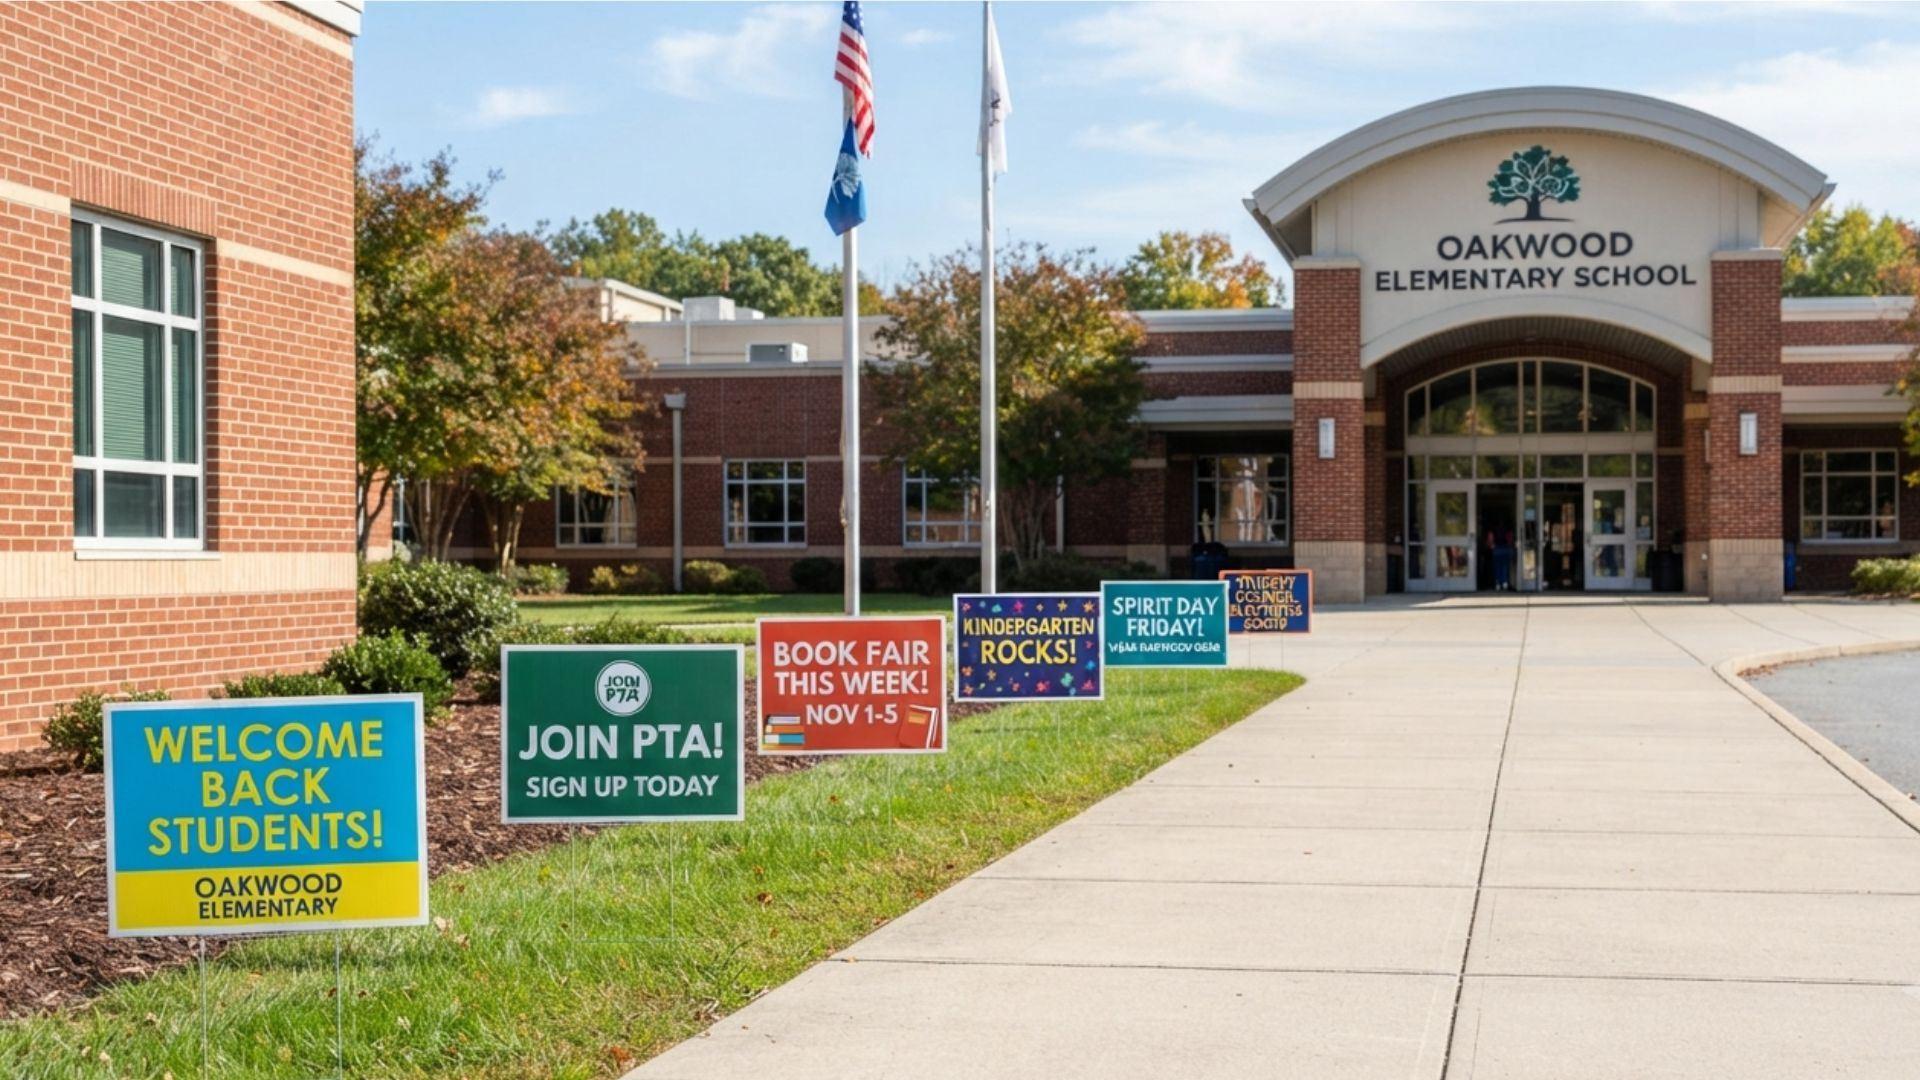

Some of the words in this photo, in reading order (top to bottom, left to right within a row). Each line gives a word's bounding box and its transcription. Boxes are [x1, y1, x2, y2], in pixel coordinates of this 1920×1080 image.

[1437, 232, 1633, 261] OAKWOOD
[1375, 266, 1565, 292] ELEMENTARY
[1574, 264, 1697, 287] SCHOOL
[1112, 597, 1172, 615] SPIRIT
[1177, 596, 1219, 616] DAY
[773, 640, 859, 667] BOOK
[866, 640, 931, 666] FAIR
[981, 638, 1077, 665] ROCKS!
[774, 671, 834, 696] THIS
[841, 671, 930, 695] WEEK!
[806, 704, 860, 725] NOV
[864, 703, 898, 725] 1-5
[144, 720, 383, 764] WELCOME
[518, 724, 619, 760] JOIN
[633, 722, 723, 759] PTA!
[202, 767, 331, 808] BACK
[526, 776, 587, 798] SIGN
[595, 775, 629, 797] UP
[634, 775, 719, 797] TODAY
[148, 809, 384, 856] STUDENTS!
[195, 873, 342, 898] OAKWOOD
[199, 897, 338, 919] ELEMENTARY
